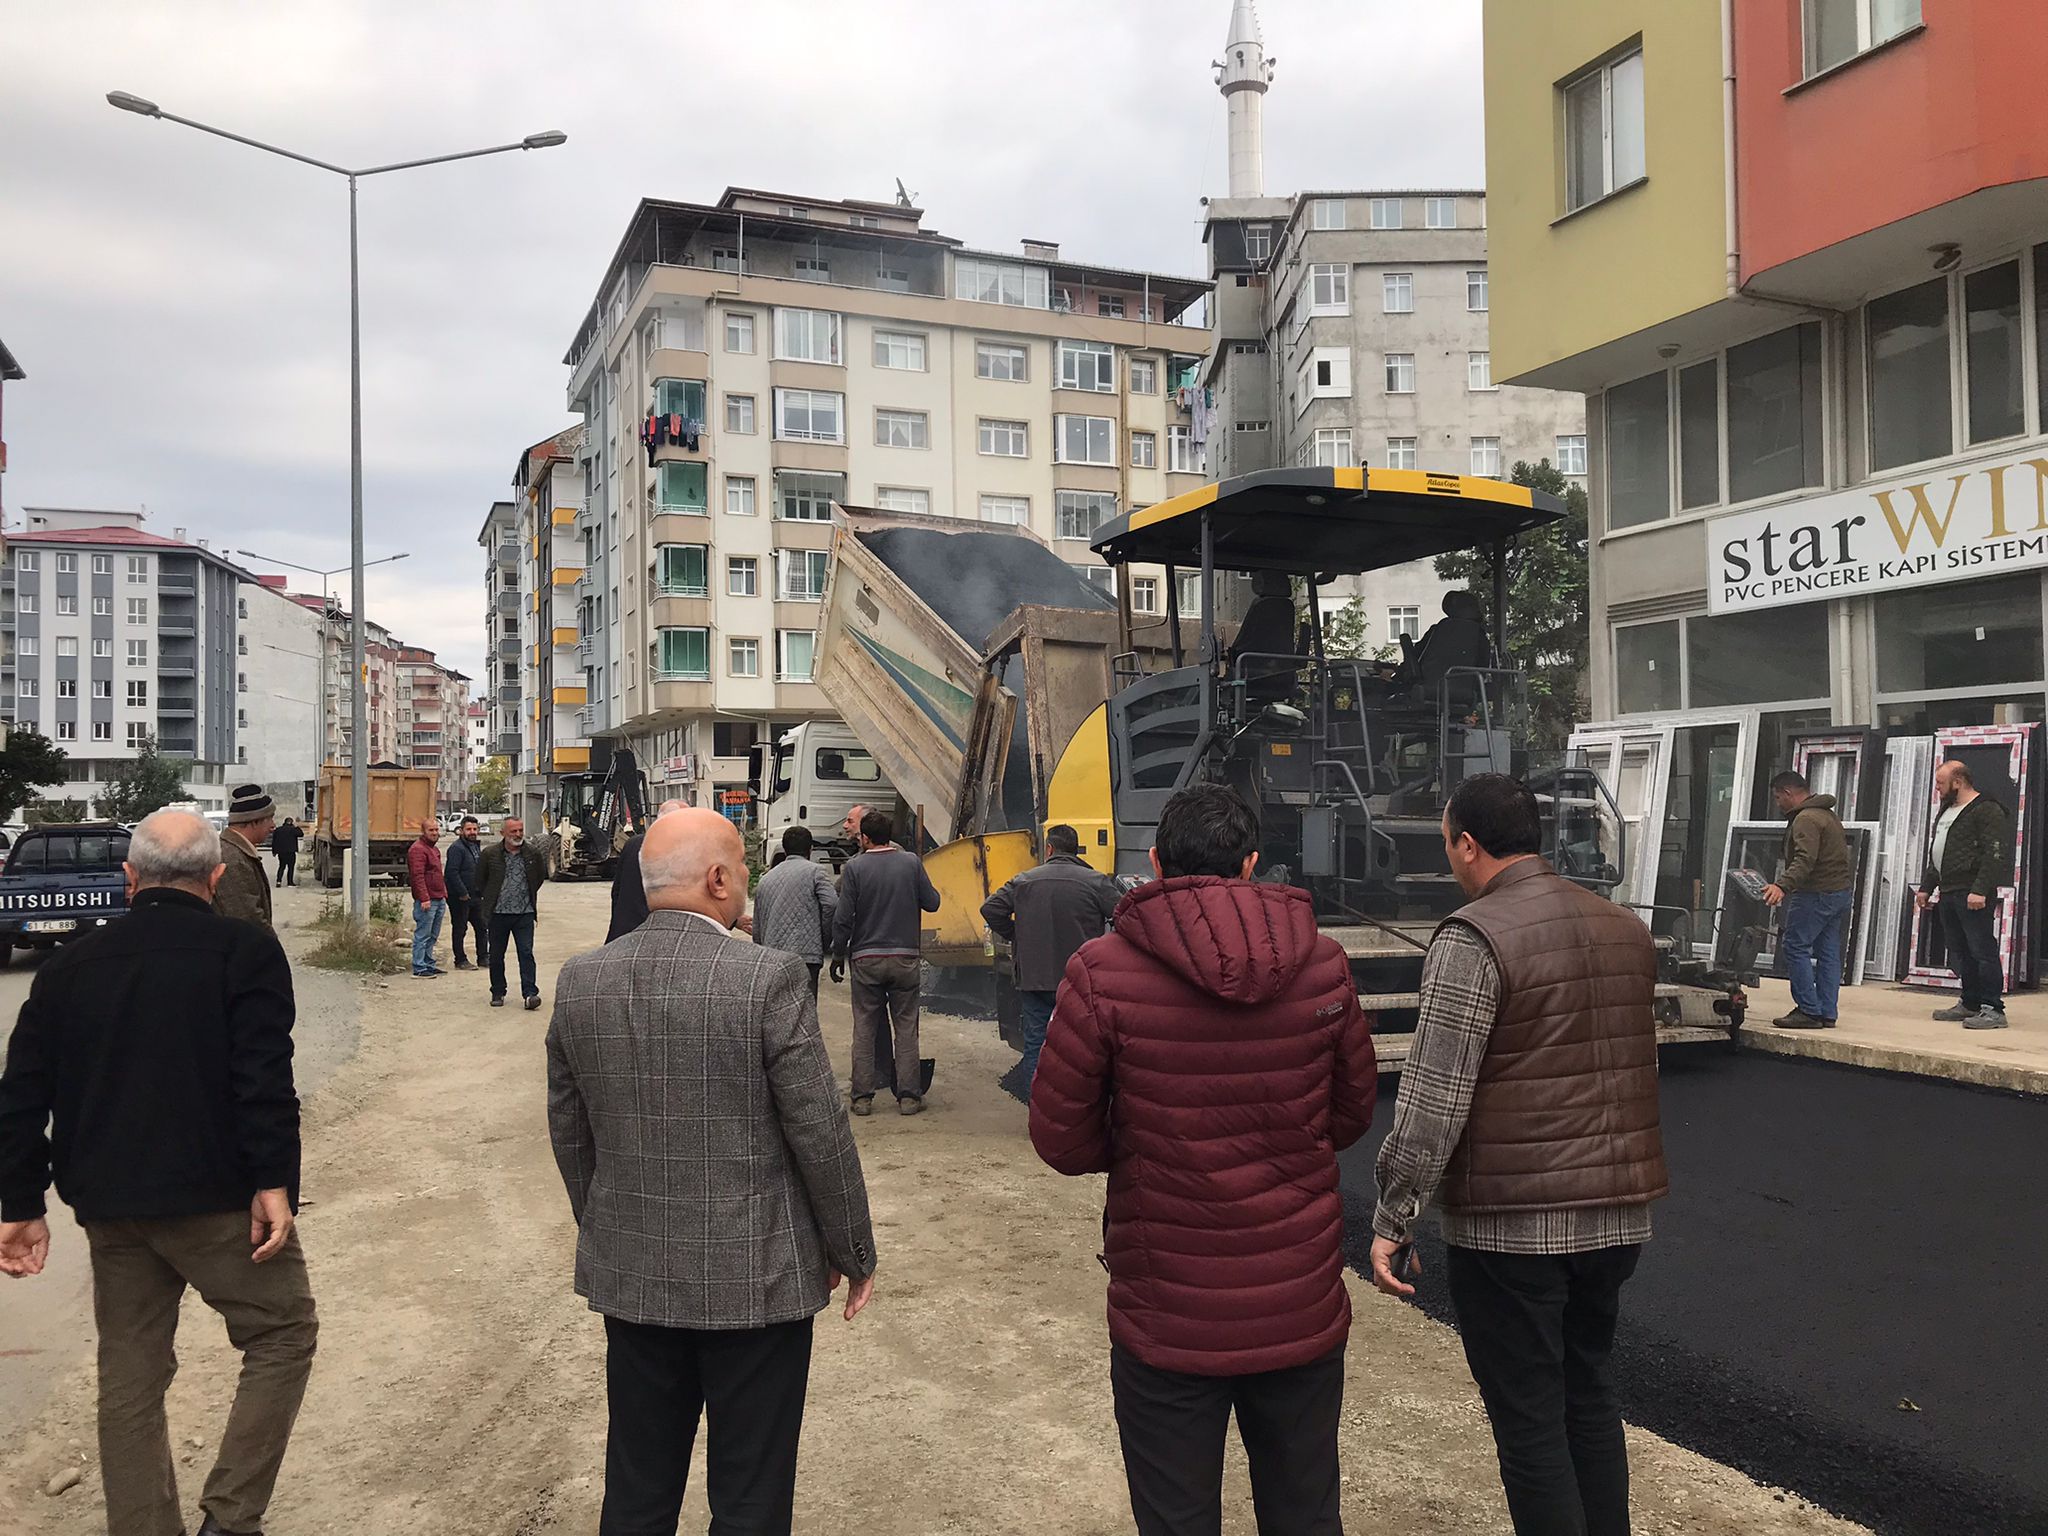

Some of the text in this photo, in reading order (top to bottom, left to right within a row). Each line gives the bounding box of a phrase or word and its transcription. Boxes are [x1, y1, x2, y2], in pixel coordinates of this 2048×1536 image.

[1725, 534, 2048, 603] PVC PENCERE KAPI SİSTEM
[0, 892, 111, 909] ITSUBISHI
